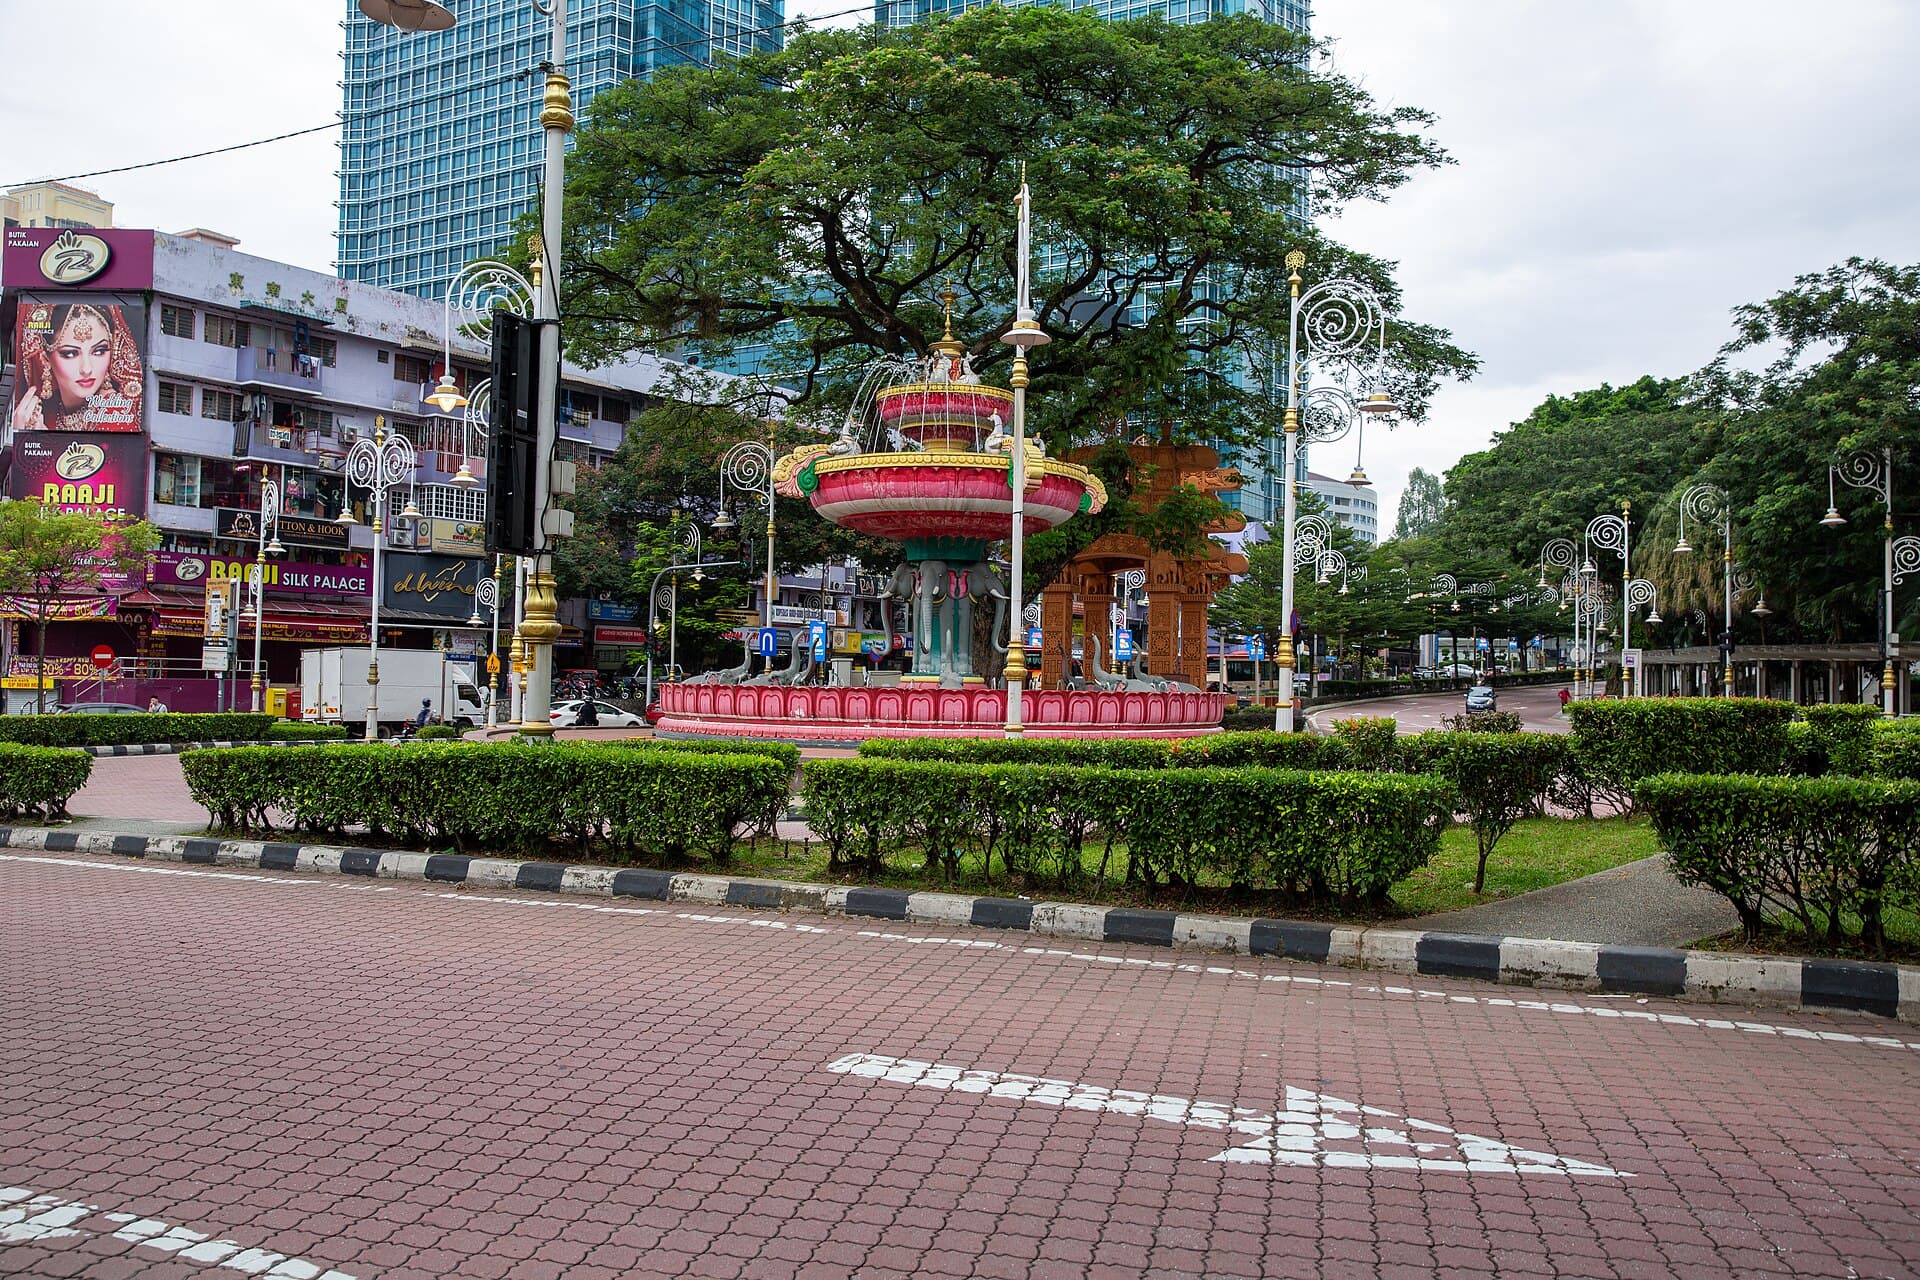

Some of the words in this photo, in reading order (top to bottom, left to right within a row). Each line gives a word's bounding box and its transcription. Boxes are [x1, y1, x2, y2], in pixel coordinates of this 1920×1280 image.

[85, 392, 133, 414] Wedding
[83, 408, 134, 423] Collections
[24, 449, 53, 457] PAKAIAN
[43, 482, 115, 505] RAAJI
[307, 524, 316, 533] &
[317, 525, 345, 536] HOOK
[282, 572, 309, 588] SILK
[313, 575, 366, 591] PALACE
[73, 663, 97, 675] 80%
